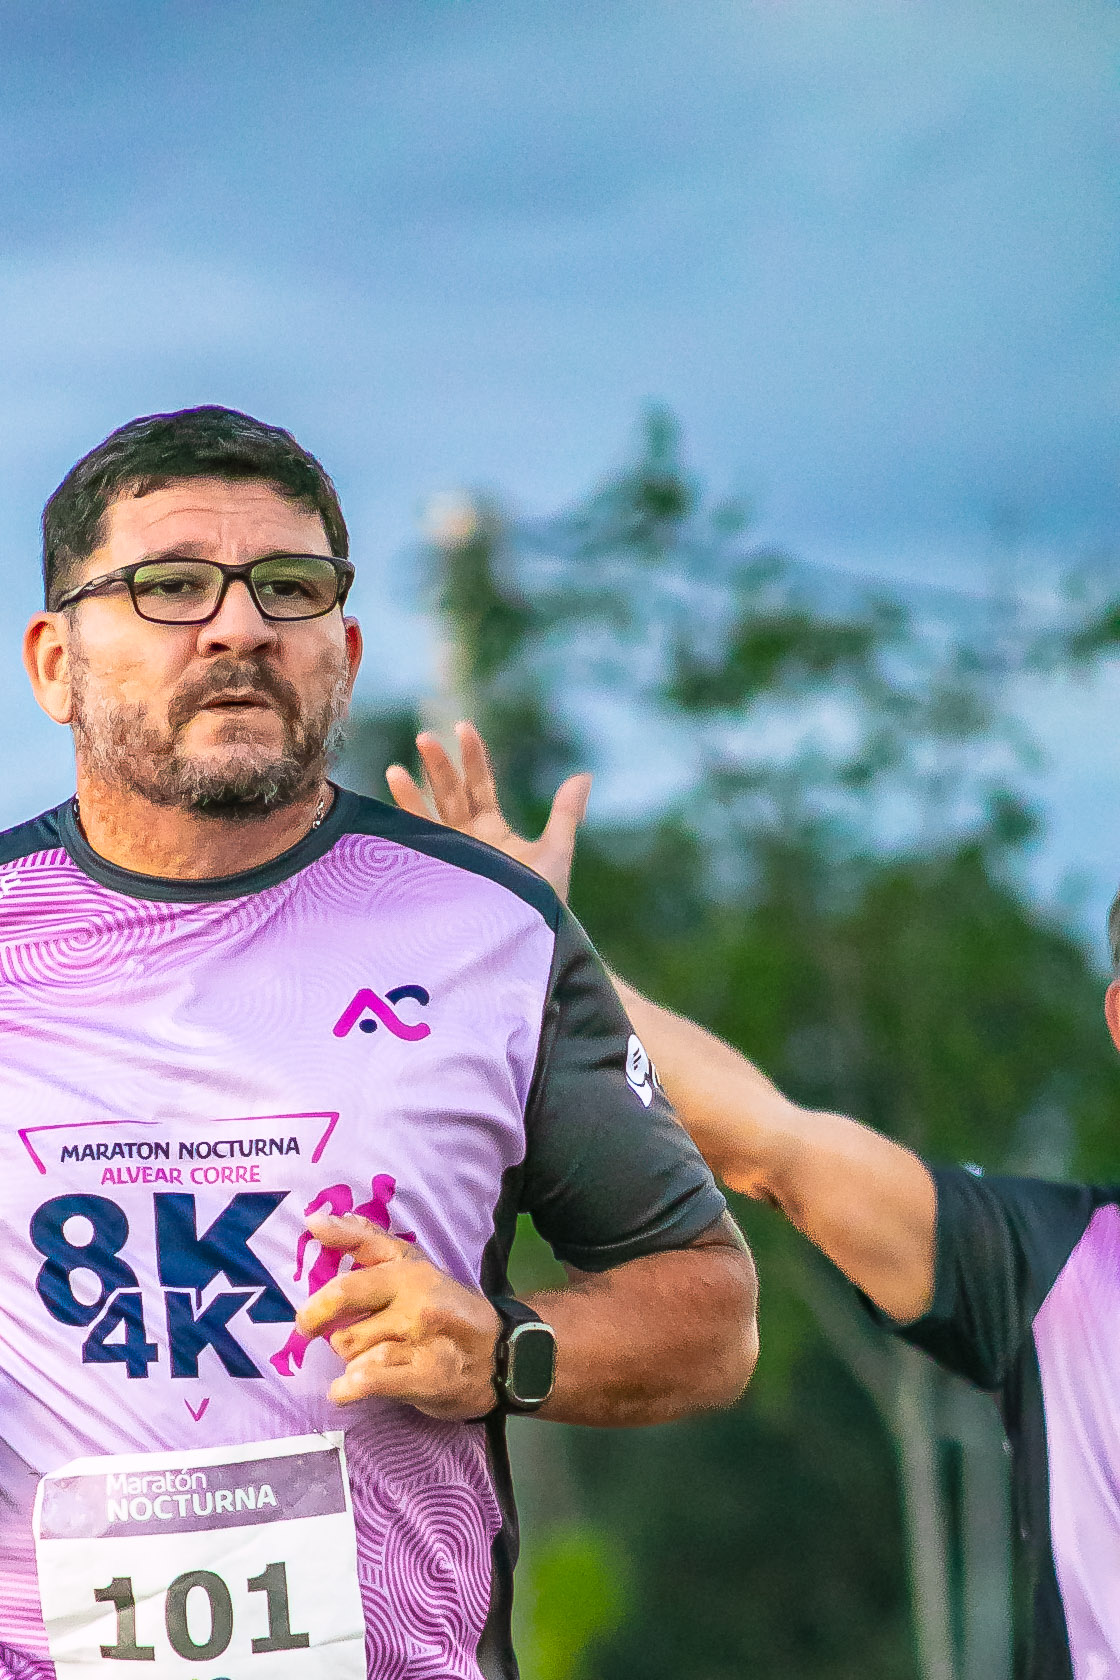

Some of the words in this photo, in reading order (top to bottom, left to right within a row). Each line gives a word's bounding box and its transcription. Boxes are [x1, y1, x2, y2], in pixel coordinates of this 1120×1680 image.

[332, 984, 431, 1041] AC
[60, 1139, 170, 1163] MARATON
[178, 1136, 301, 1161] NOCTURNA
[100, 1166, 182, 1186] ALVEAR
[190, 1164, 262, 1184] CORRE
[30, 1190, 297, 1327] 8K
[82, 1291, 265, 1379] 4K
[106, 1468, 207, 1496] Maratón
[107, 1484, 278, 1523] NOCTURNA
[93, 1561, 311, 1662] 101
